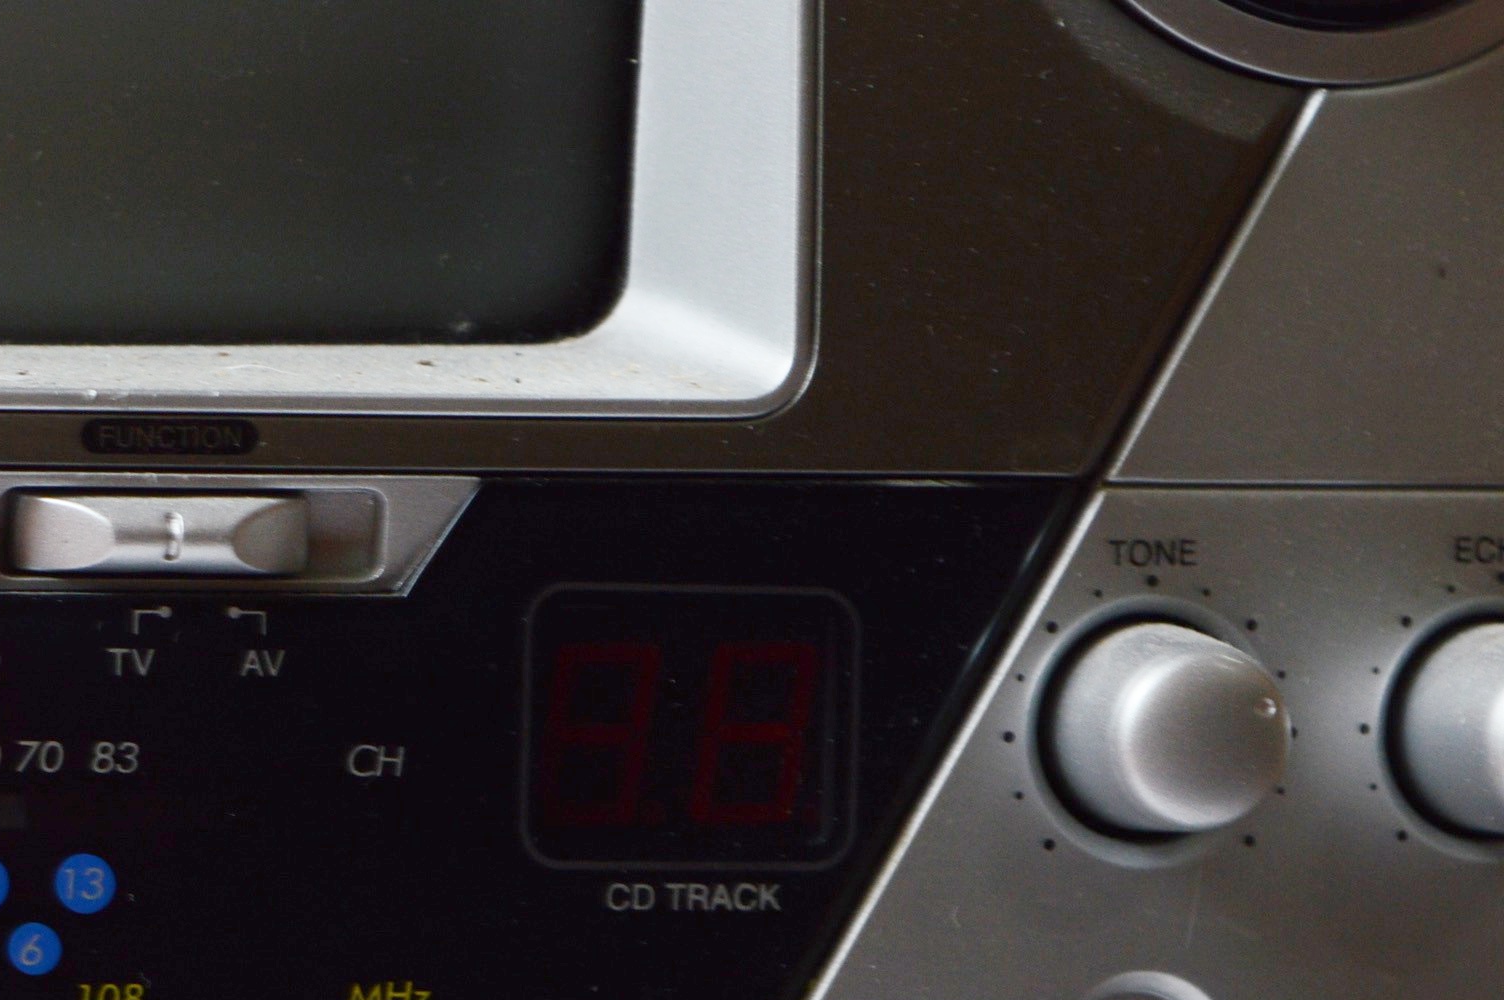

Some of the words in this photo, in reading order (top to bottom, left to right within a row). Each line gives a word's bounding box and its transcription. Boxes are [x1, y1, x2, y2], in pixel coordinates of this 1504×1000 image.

[96, 421, 245, 451] FUNCTION
[1109, 540, 1198, 567] TONE
[106, 647, 155, 676] TV
[240, 649, 285, 677] AV
[16, 740, 64, 773] 70
[91, 741, 140, 774] 83
[347, 744, 405, 778] CH
[64, 866, 105, 900] 13
[606, 882, 655, 912] CD
[664, 882, 781, 912] TRACK
[18, 934, 43, 966] 6
